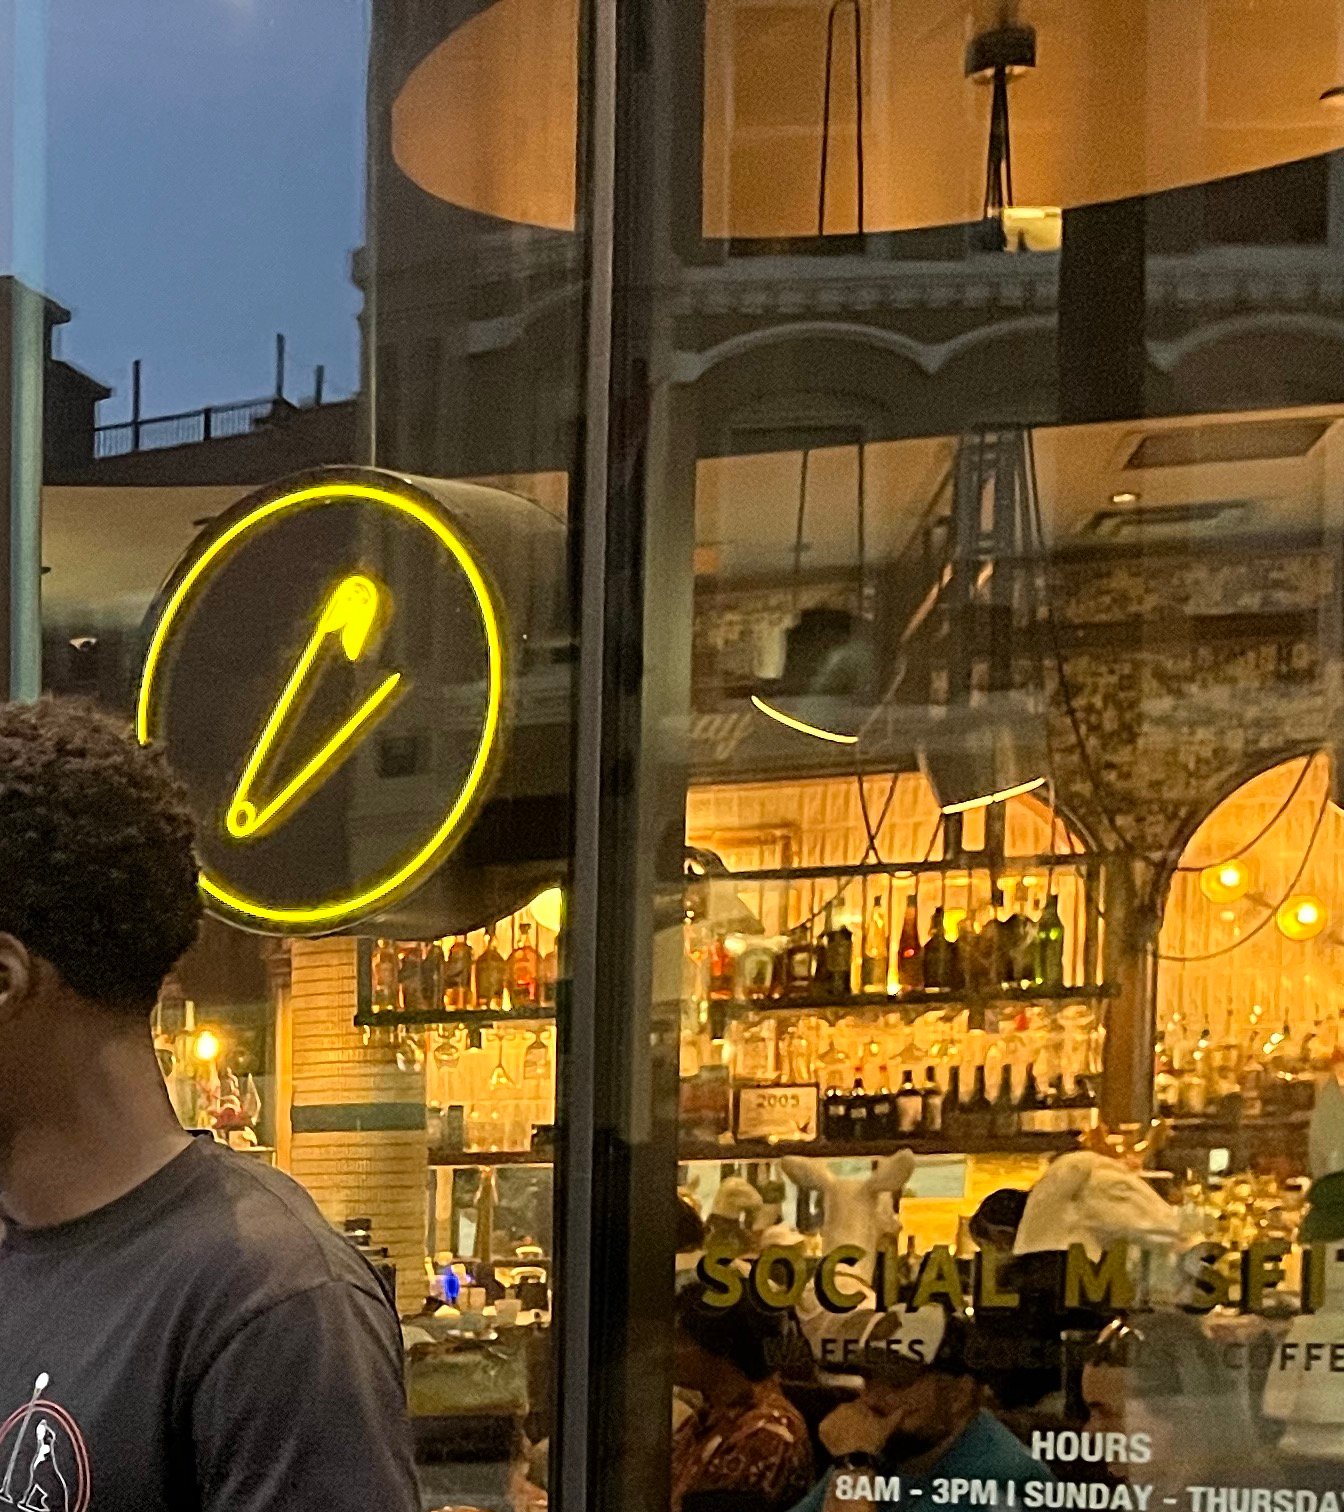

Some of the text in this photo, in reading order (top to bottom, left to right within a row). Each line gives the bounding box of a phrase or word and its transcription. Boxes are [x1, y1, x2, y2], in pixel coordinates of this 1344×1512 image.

[697, 1240, 1344, 1315] SOCIAL MISFI
[1032, 1431, 1152, 1463] HOURS
[835, 1475, 900, 1502] 8AM
[932, 1478, 997, 1505] 3PM
[1024, 1481, 1153, 1511] SUNDAY
